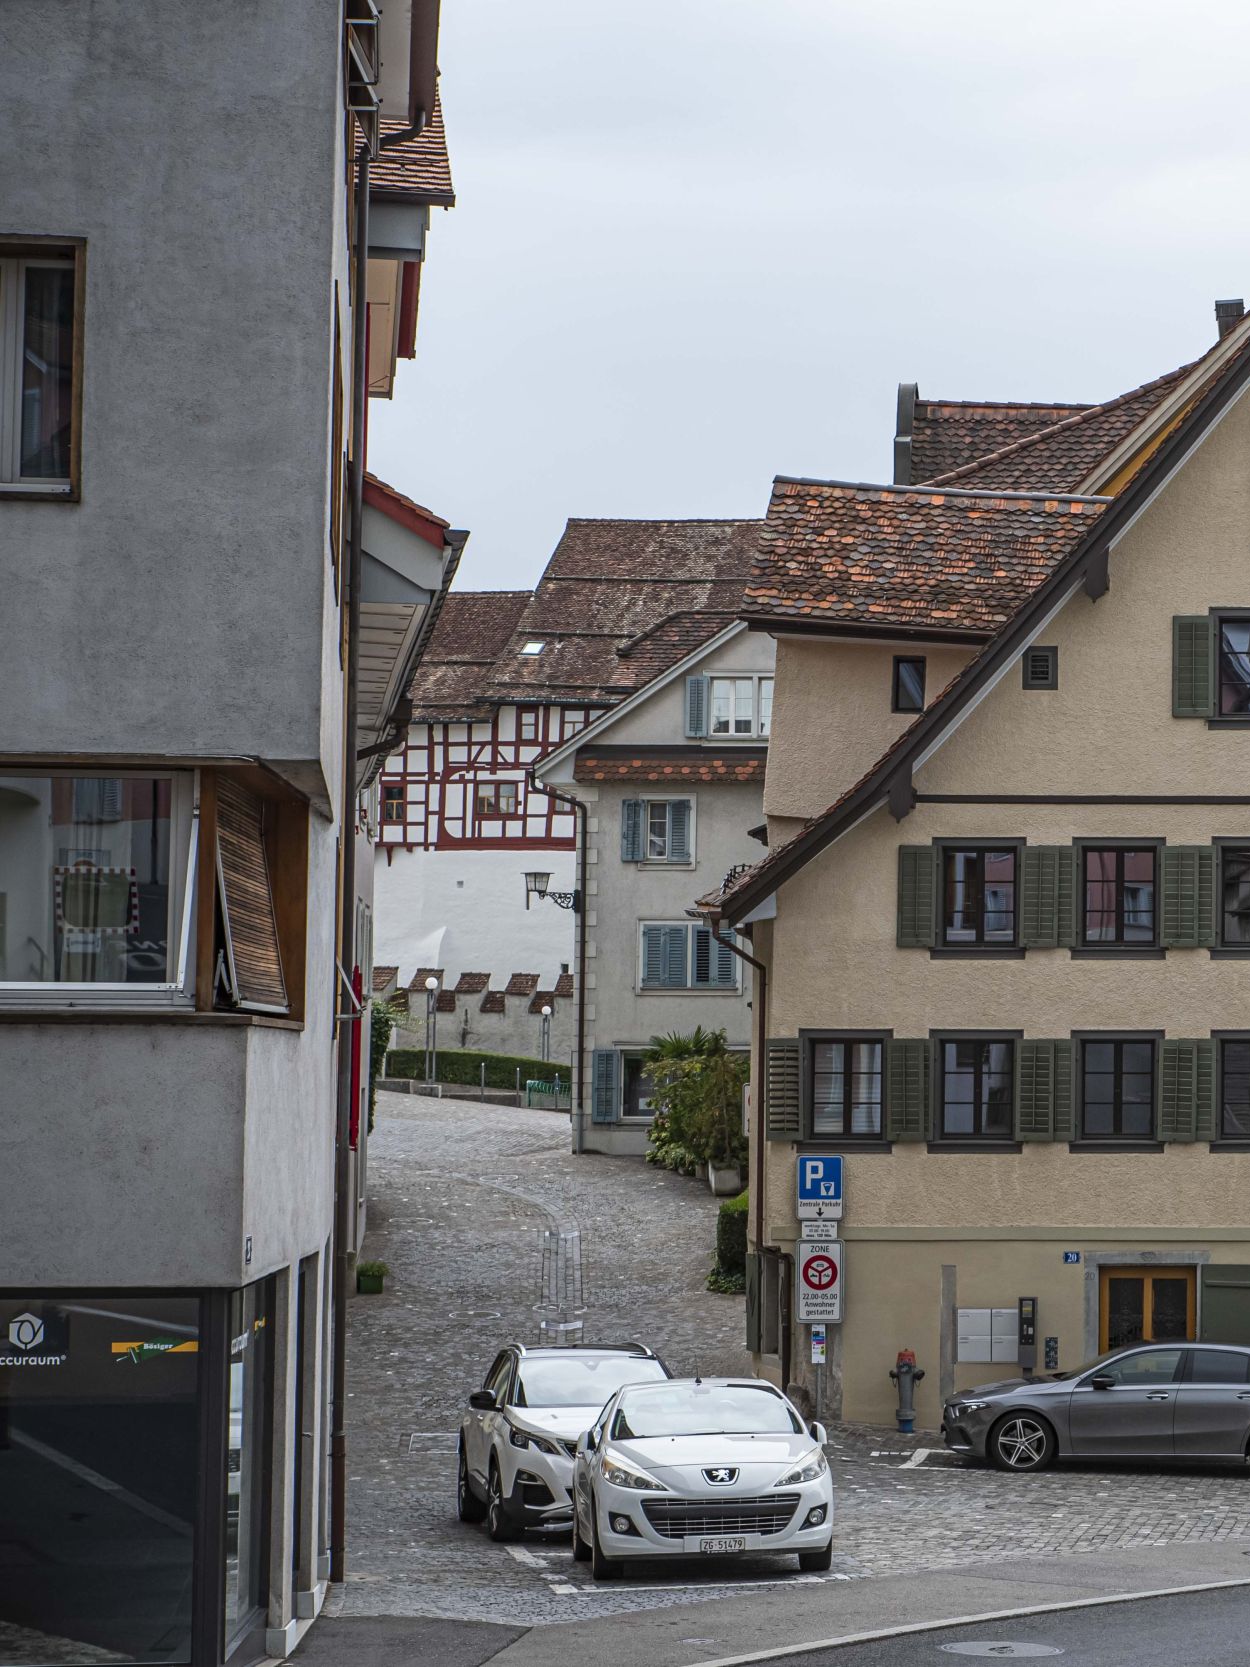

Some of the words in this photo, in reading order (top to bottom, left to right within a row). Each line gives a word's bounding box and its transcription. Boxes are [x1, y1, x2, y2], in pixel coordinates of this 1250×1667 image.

[805, 1160, 824, 1190] P
[810, 1245, 830, 1253] ZONE
[1067, 1253, 1077, 1262] 20
[1084, 1271, 1096, 1281] 20
[805, 1308, 834, 1316] gestattet
[143, 1342, 174, 1351] Bösiger
